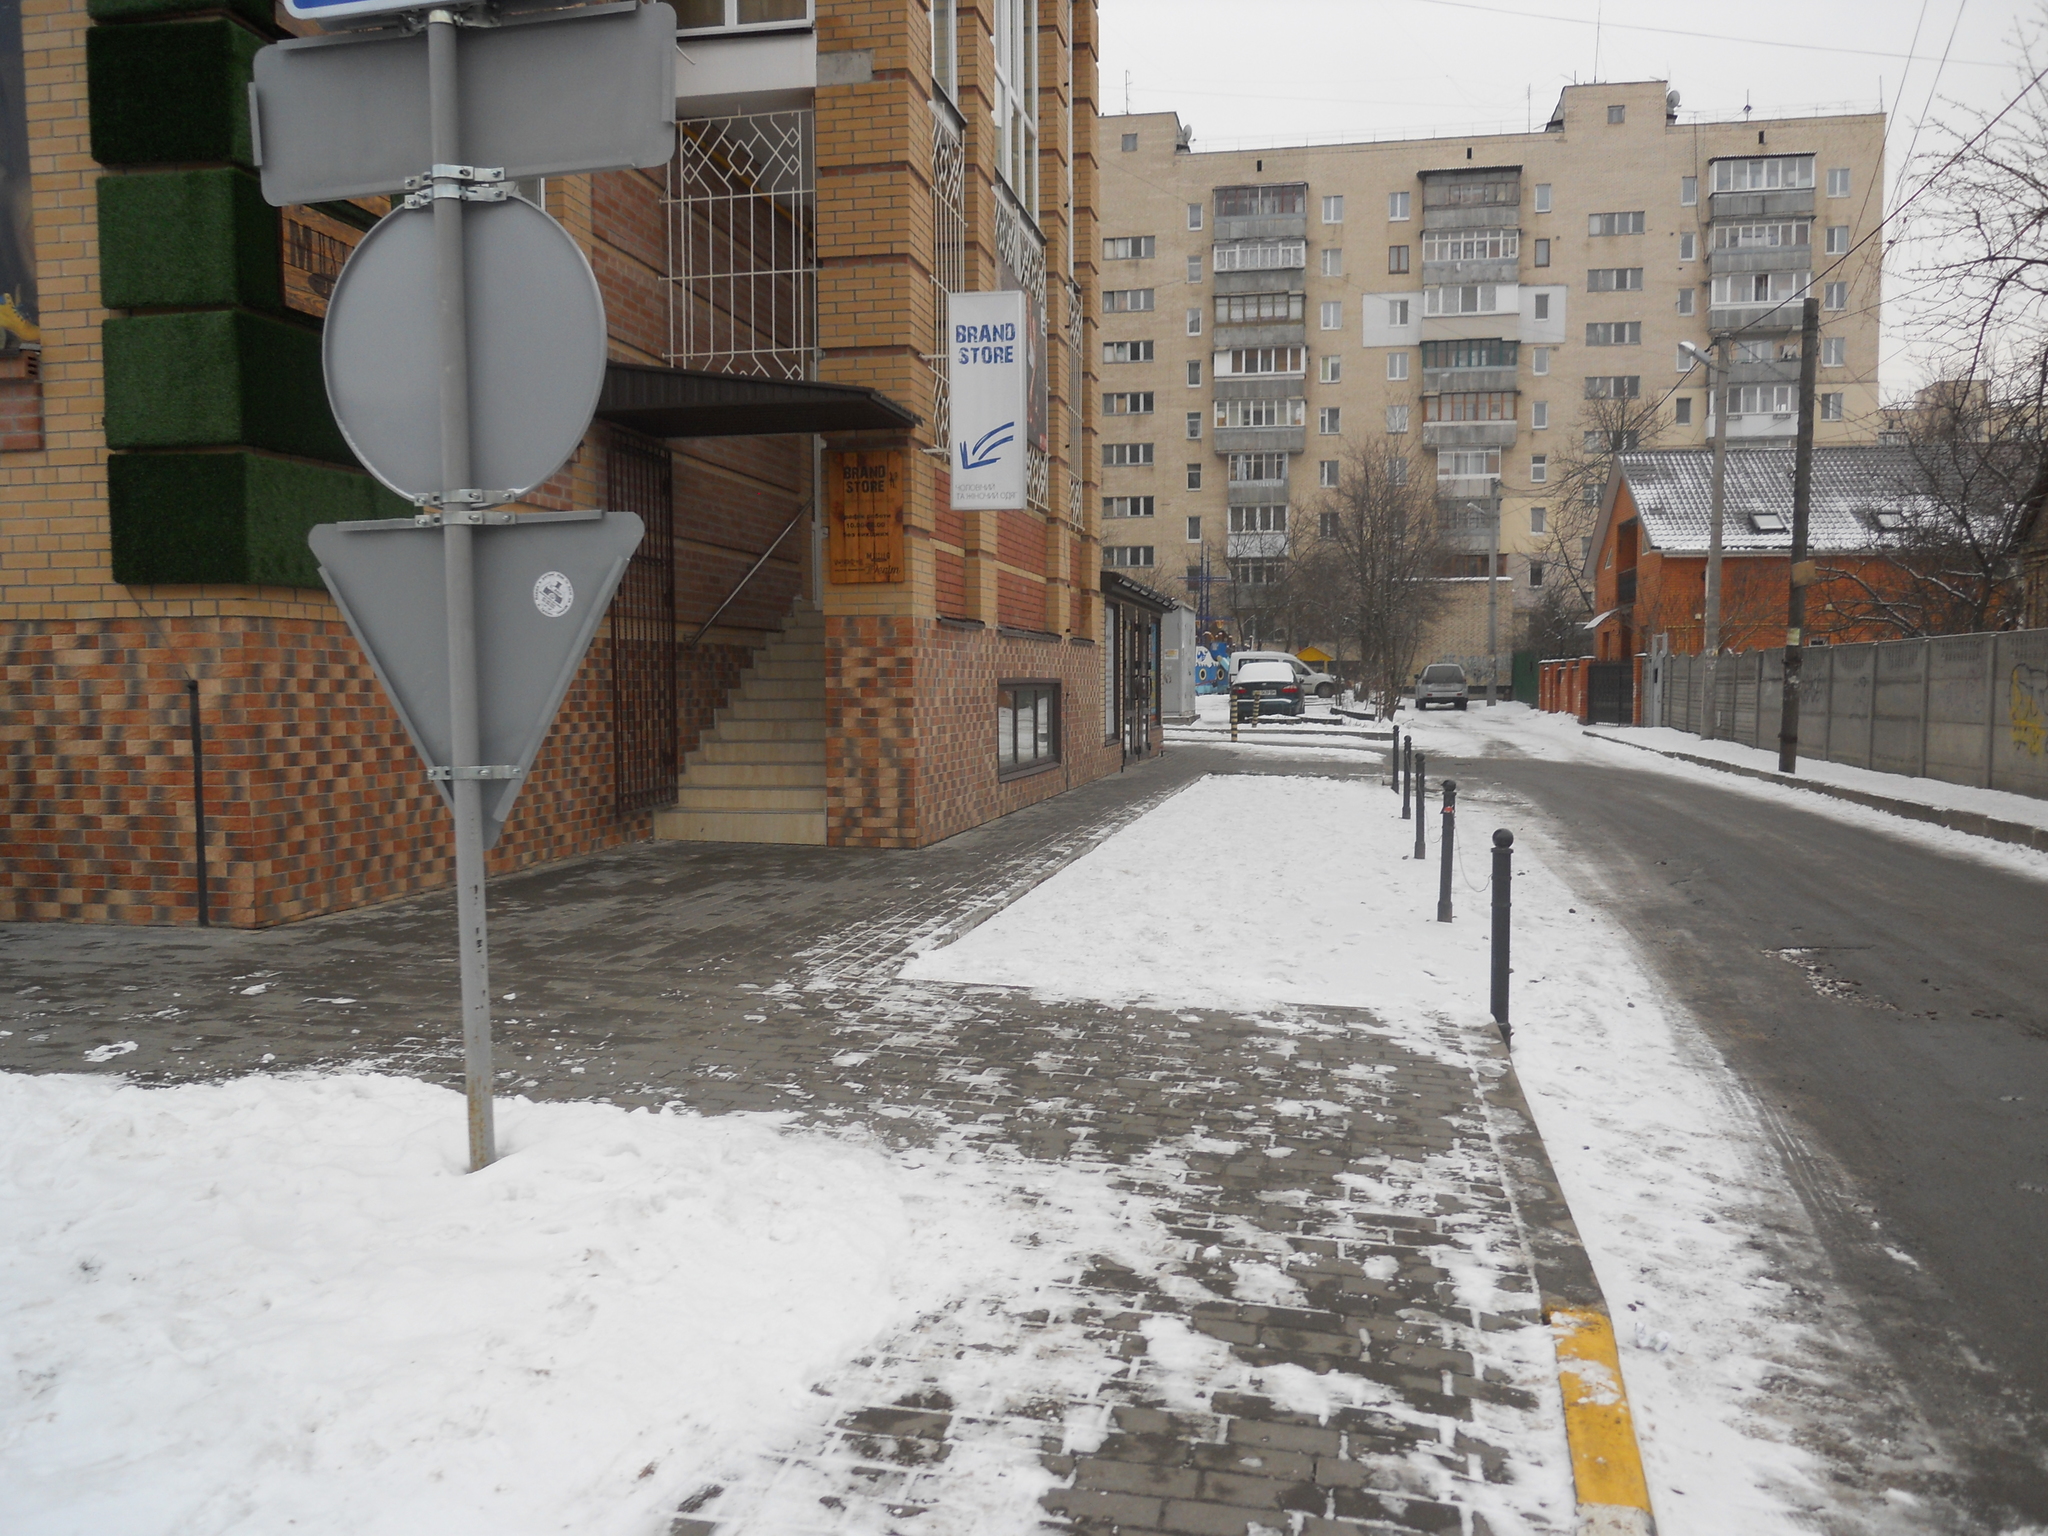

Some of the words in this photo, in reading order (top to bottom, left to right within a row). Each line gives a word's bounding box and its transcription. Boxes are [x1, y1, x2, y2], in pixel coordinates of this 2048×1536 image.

[956, 322, 1016, 343] BRAND
[958, 345, 1014, 365] STORE
[844, 466, 886, 478] BRAND
[846, 480, 885, 493] STORE
[957, 492, 965, 500] ТА
[1000, 491, 1018, 501] ОДЯГ
